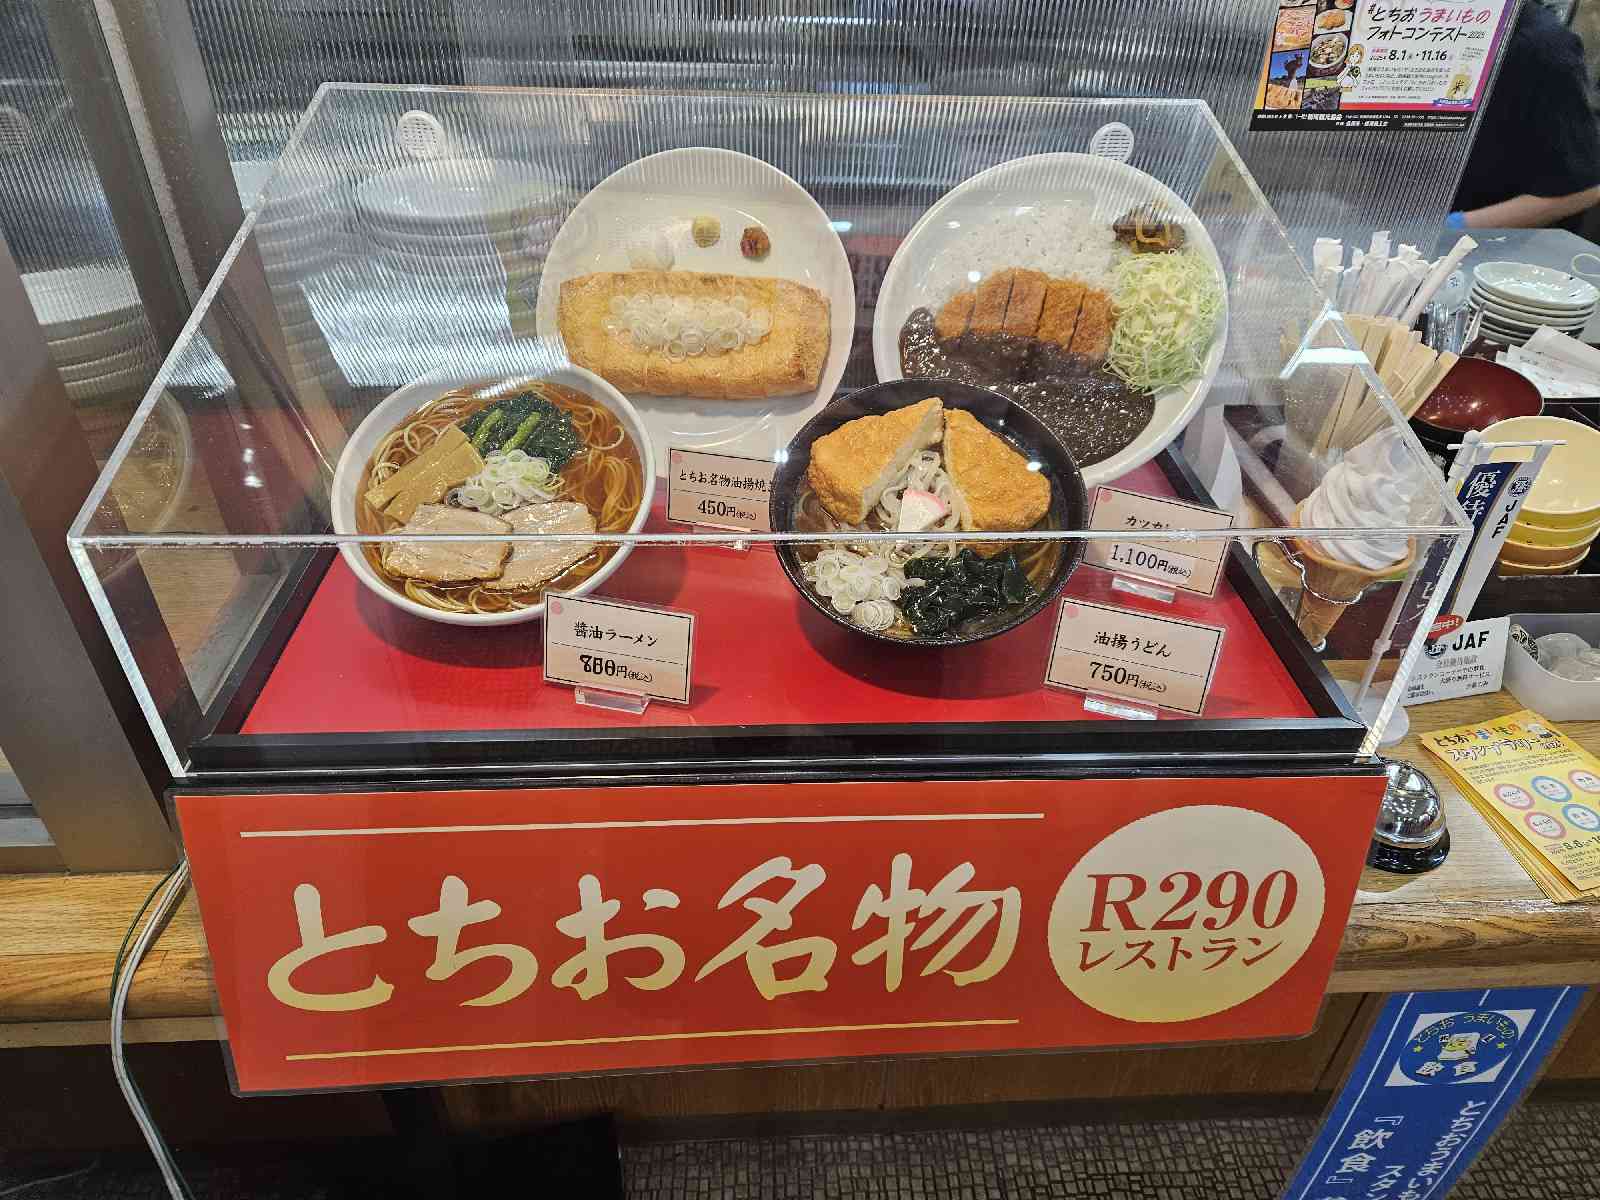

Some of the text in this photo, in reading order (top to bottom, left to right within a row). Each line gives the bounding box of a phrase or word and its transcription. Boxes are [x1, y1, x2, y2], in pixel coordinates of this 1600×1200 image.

[1491, 499, 1518, 539] JAF
[573, 621, 658, 647] 醤油ラーメン
[1093, 631, 1172, 658] 油揚うどん
[1452, 630, 1490, 651] JAF
[1080, 870, 1298, 932] R290
[267, 853, 1022, 1013] とちお名物
[1079, 937, 1284, 971] レストラン
